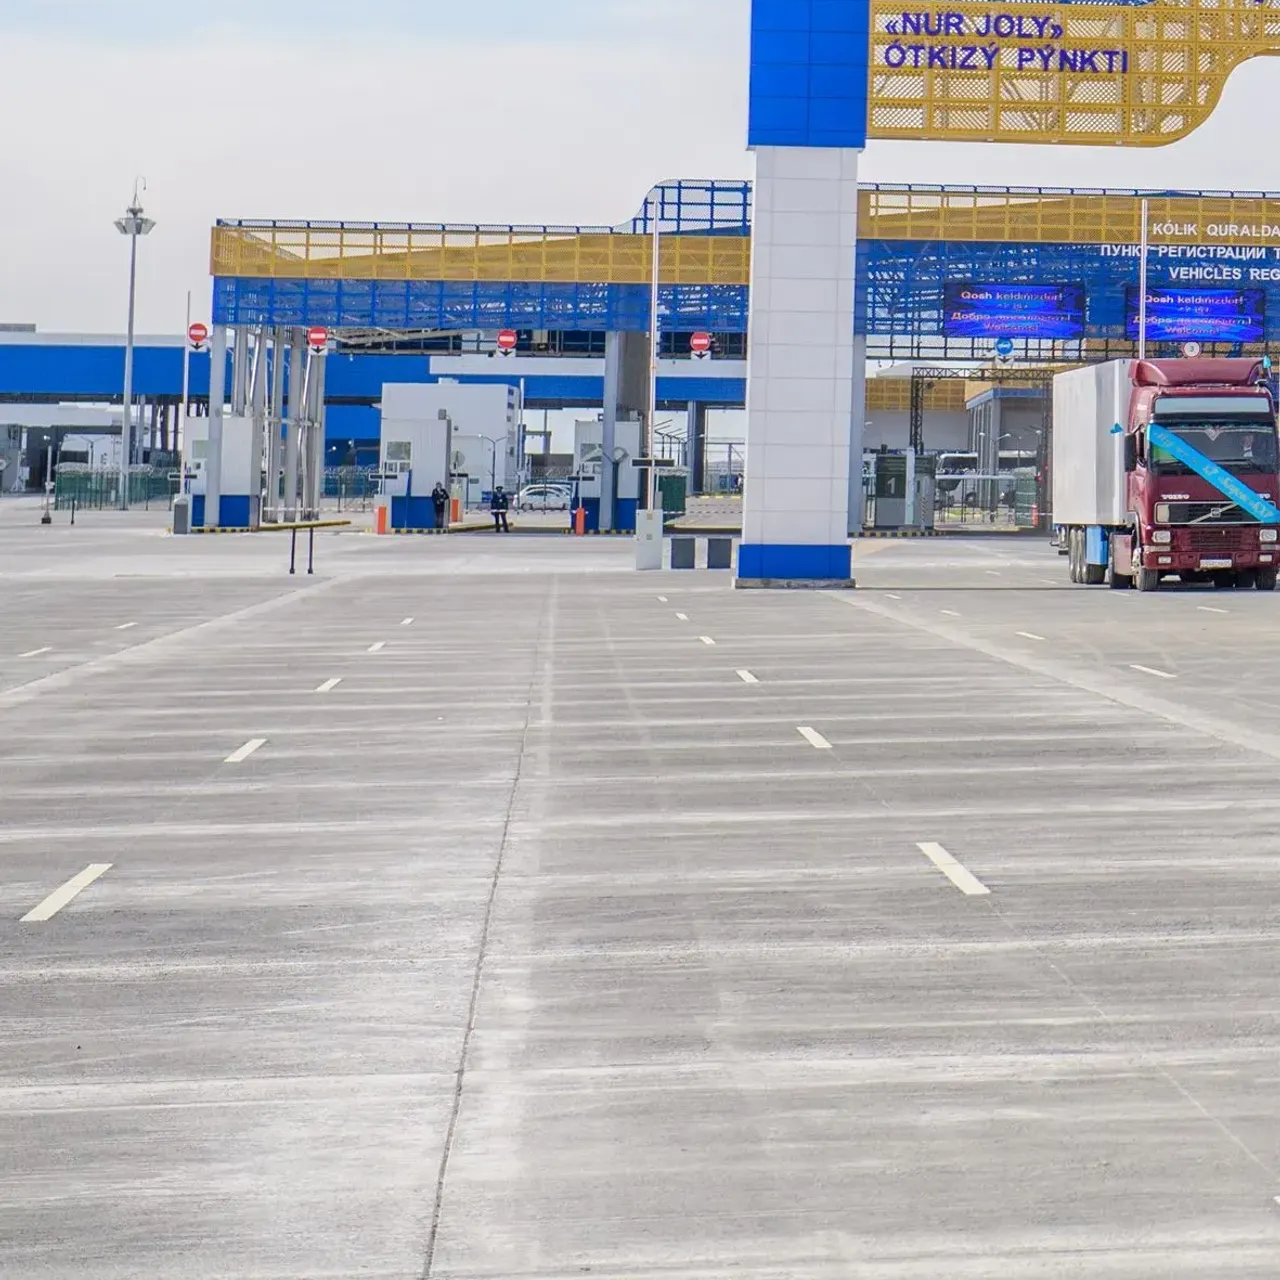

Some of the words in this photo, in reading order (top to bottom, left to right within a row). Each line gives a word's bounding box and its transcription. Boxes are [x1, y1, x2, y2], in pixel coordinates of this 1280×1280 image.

[885, 12, 965, 37] «NUR
[976, 14, 1064, 38] JOLY»
[884, 39, 999, 70] ÓTKIZÝ
[1017, 43, 1128, 73] PÝNKTI
[1153, 220, 1198, 236] KÓLIK
[1158, 246, 1266, 261] РЕГИСТРАЦИИ
[1169, 267, 1242, 280] VEHICLES
